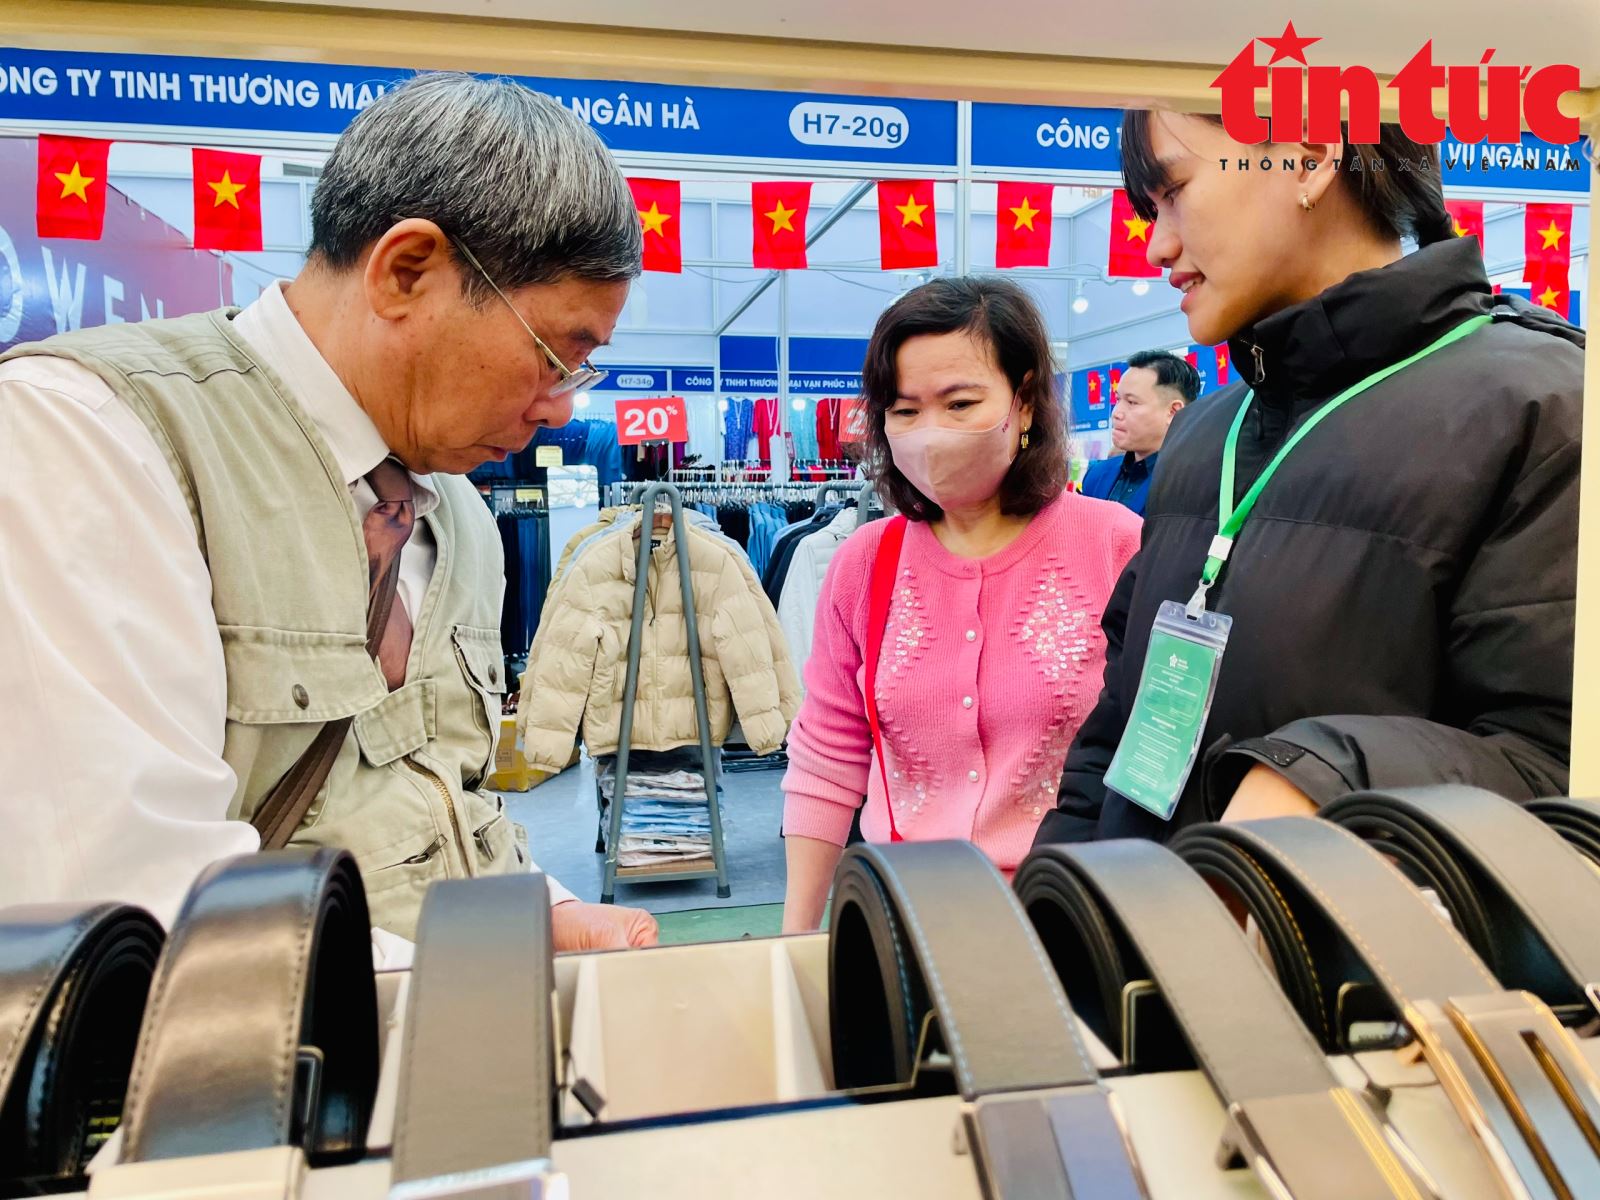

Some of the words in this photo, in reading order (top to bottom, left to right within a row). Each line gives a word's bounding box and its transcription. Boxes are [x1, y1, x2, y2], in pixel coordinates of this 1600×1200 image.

[66, 68, 102, 98] TY
[110, 70, 182, 101] TINH
[189, 71, 320, 109] THƯƠNG
[571, 92, 653, 127] NGÂN
[661, 96, 701, 130] HÀ
[802, 112, 904, 144] H7-20g
[1036, 117, 1111, 150] CÔNG
[1481, 142, 1541, 170] NGÂN
[1546, 144, 1574, 171] HÀ
[620, 376, 653, 387] H7-34g
[685, 375, 713, 387] CÔNG
[725, 377, 748, 388] TNHH
[749, 377, 778, 388] THƯƠN
[803, 379, 822, 390] VẠN
[822, 377, 846, 389] PHÚC
[623, 404, 679, 437] 20%
